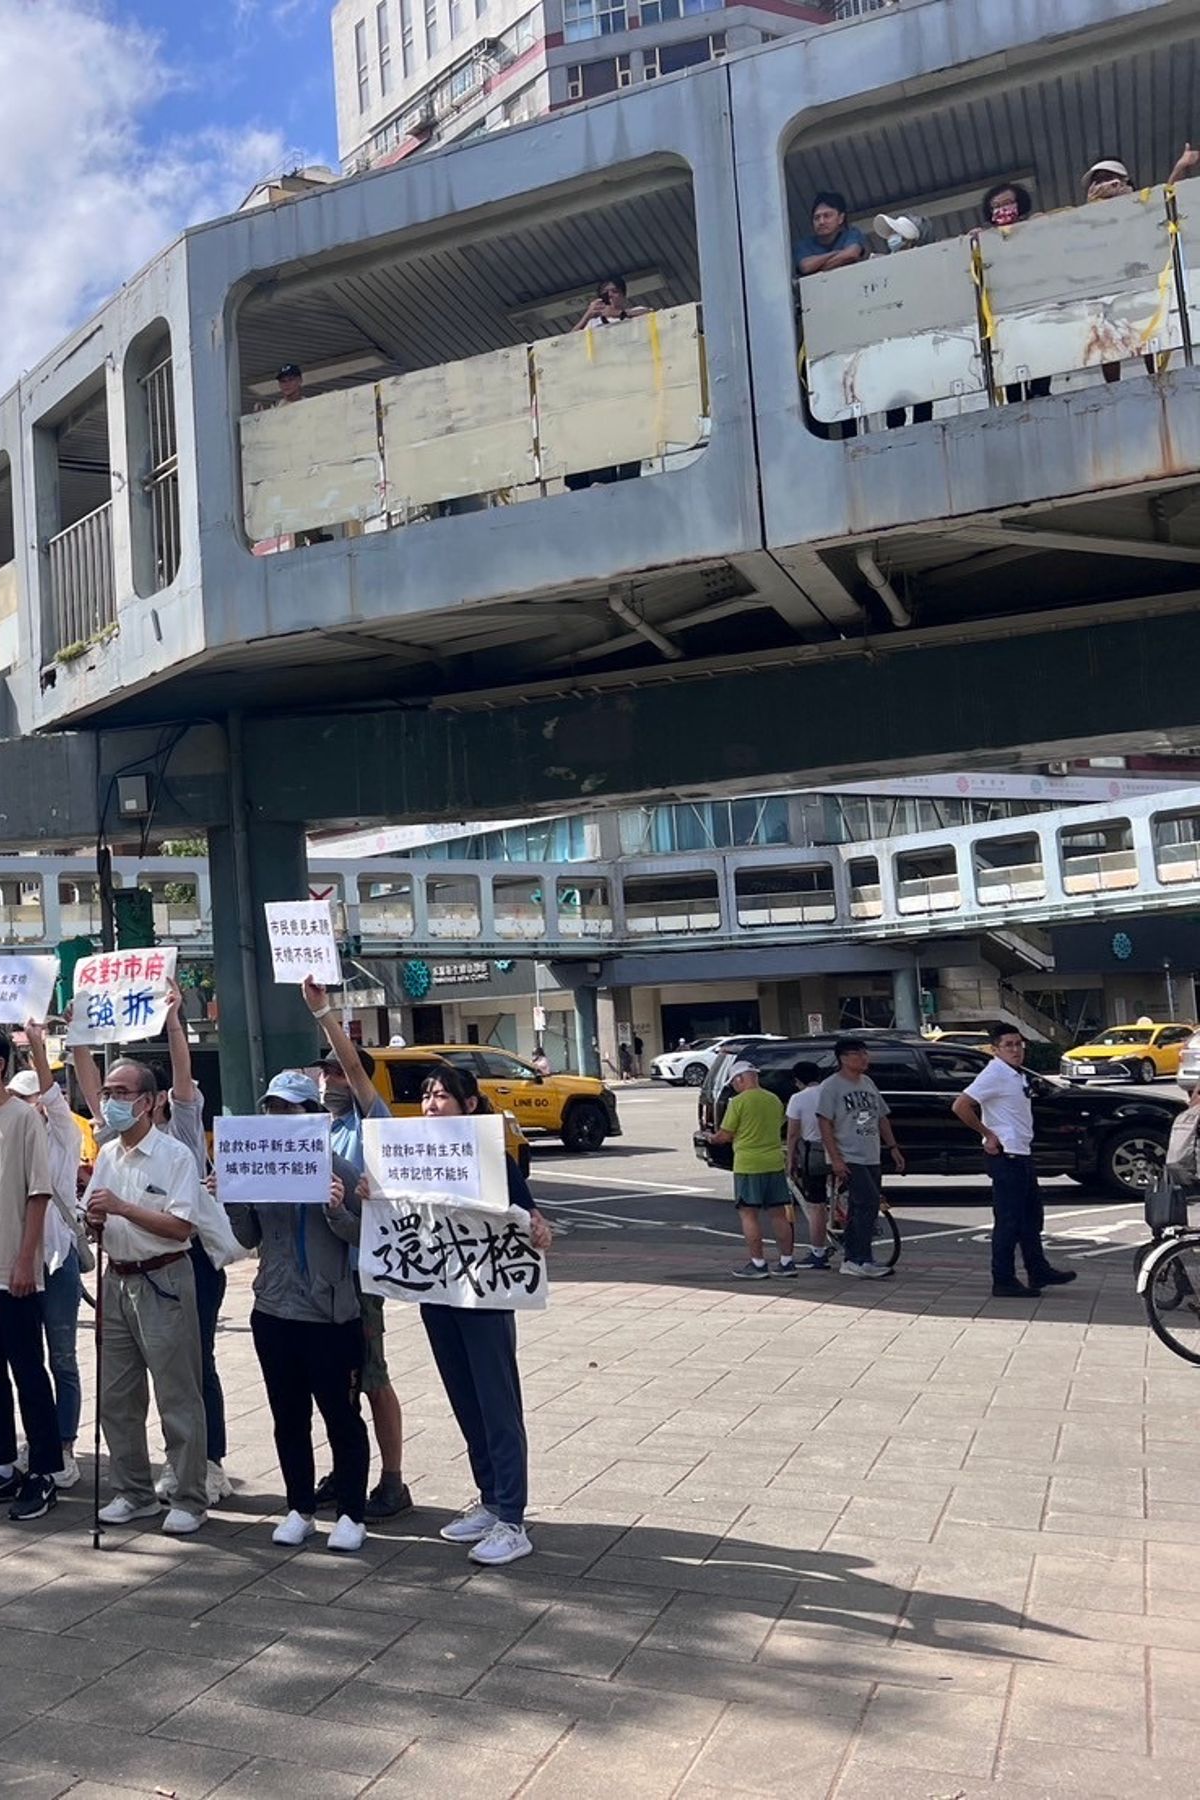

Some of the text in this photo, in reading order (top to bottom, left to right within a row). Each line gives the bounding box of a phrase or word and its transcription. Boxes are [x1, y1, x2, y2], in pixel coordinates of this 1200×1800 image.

[269, 919, 331, 937] 市民意見未聽
[78, 953, 165, 988] 反對市府
[86, 986, 155, 1029] 強拆
[513, 1097, 549, 1107] LINE GO
[218, 1138, 325, 1153] 搶救和平新生天橋
[381, 1141, 474, 1158] 搶救和平新生天橋
[225, 1161, 319, 1175] 城市記憶不能拆
[388, 1166, 469, 1182] 城市記憶不能拆
[371, 1215, 542, 1298] 還我橋
